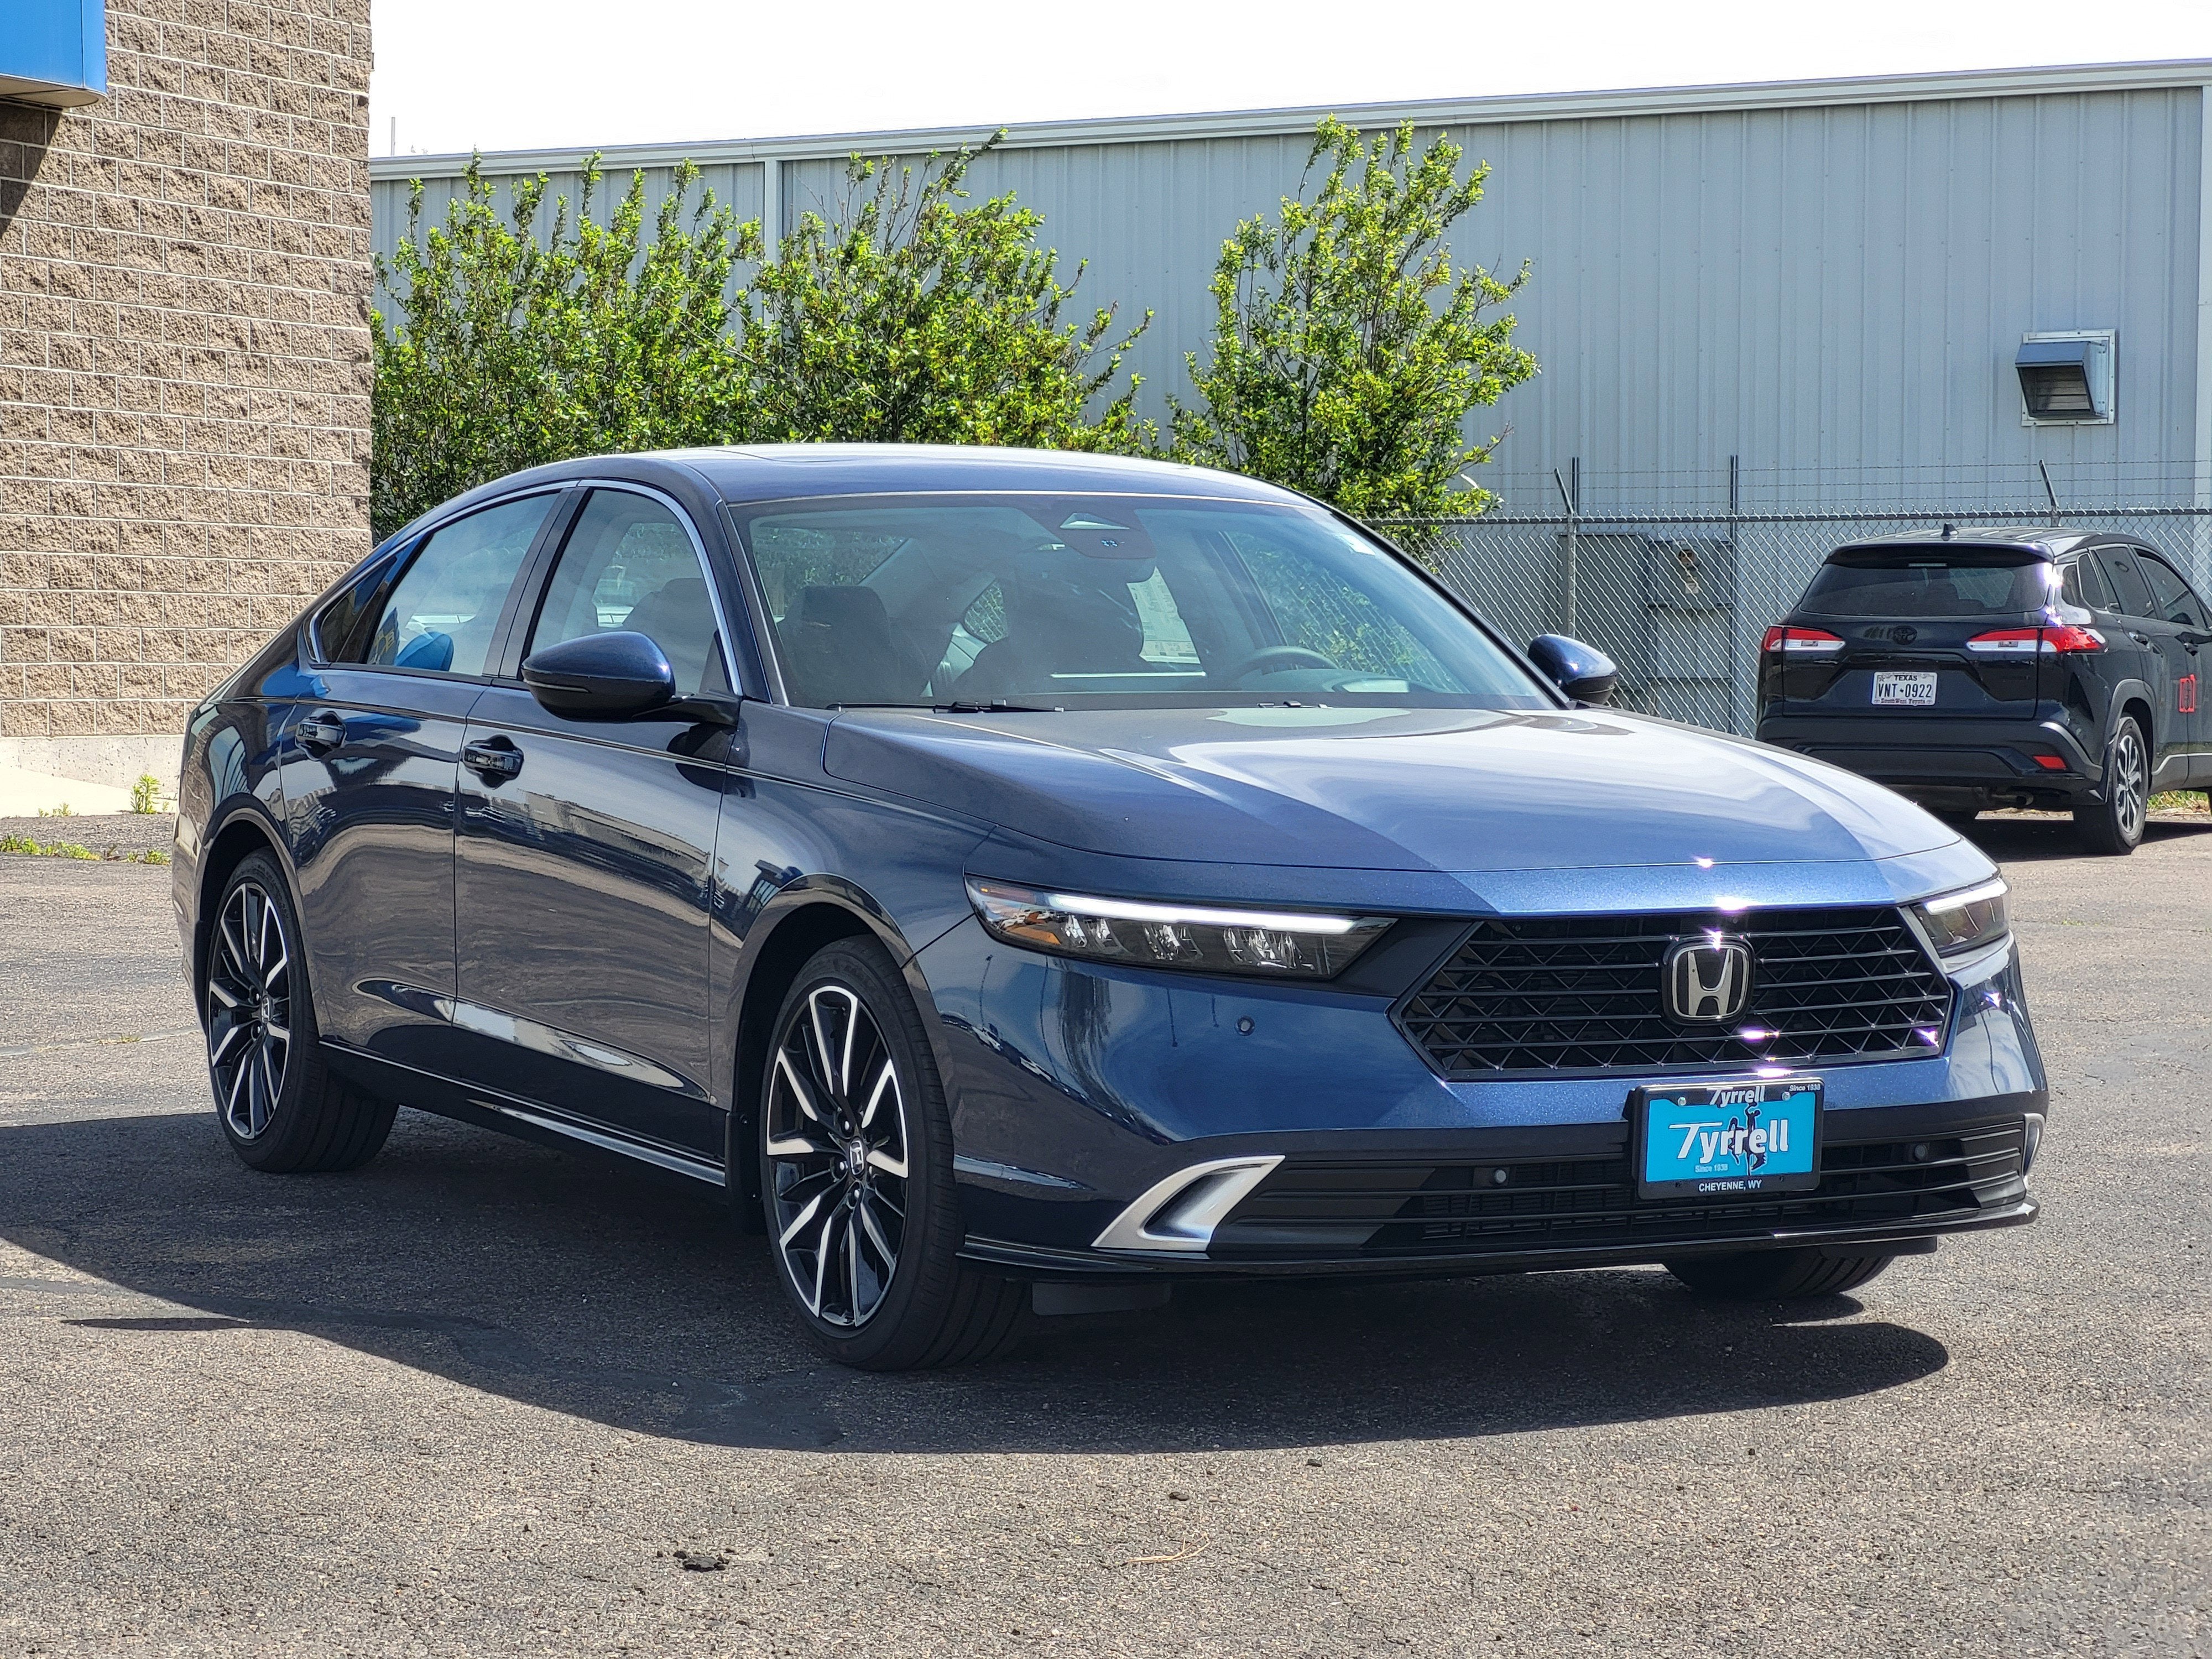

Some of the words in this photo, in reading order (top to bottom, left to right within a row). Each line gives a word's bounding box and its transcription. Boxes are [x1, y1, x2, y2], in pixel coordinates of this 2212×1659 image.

[1706, 1086, 1765, 1108] Tyrrell
[1668, 1119, 1790, 1164] Tyrrell
[1698, 1181, 1746, 1192] CHEYENNE,
[1747, 1179, 1762, 1189] WY
